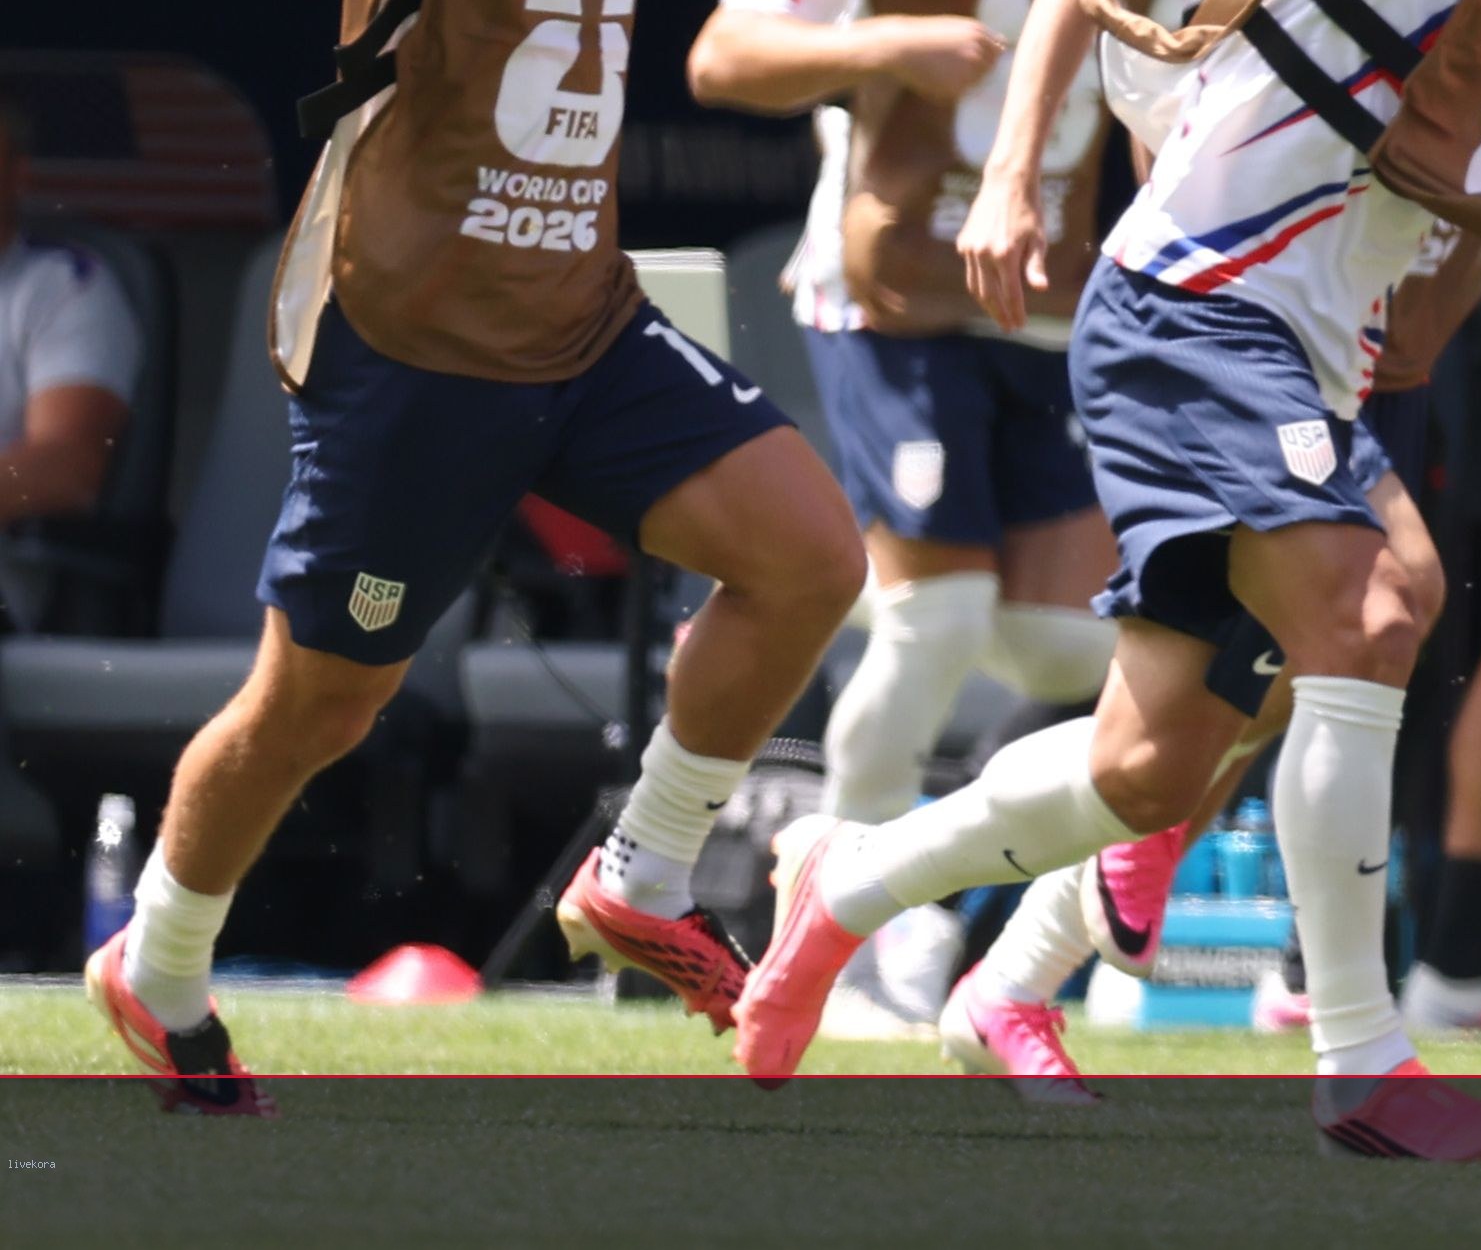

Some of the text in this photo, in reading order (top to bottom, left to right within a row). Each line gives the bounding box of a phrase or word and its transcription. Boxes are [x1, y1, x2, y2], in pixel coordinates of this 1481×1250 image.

[544, 106, 599, 139] FIFA
[459, 197, 599, 254] 2026
[359, 575, 401, 602] USA
